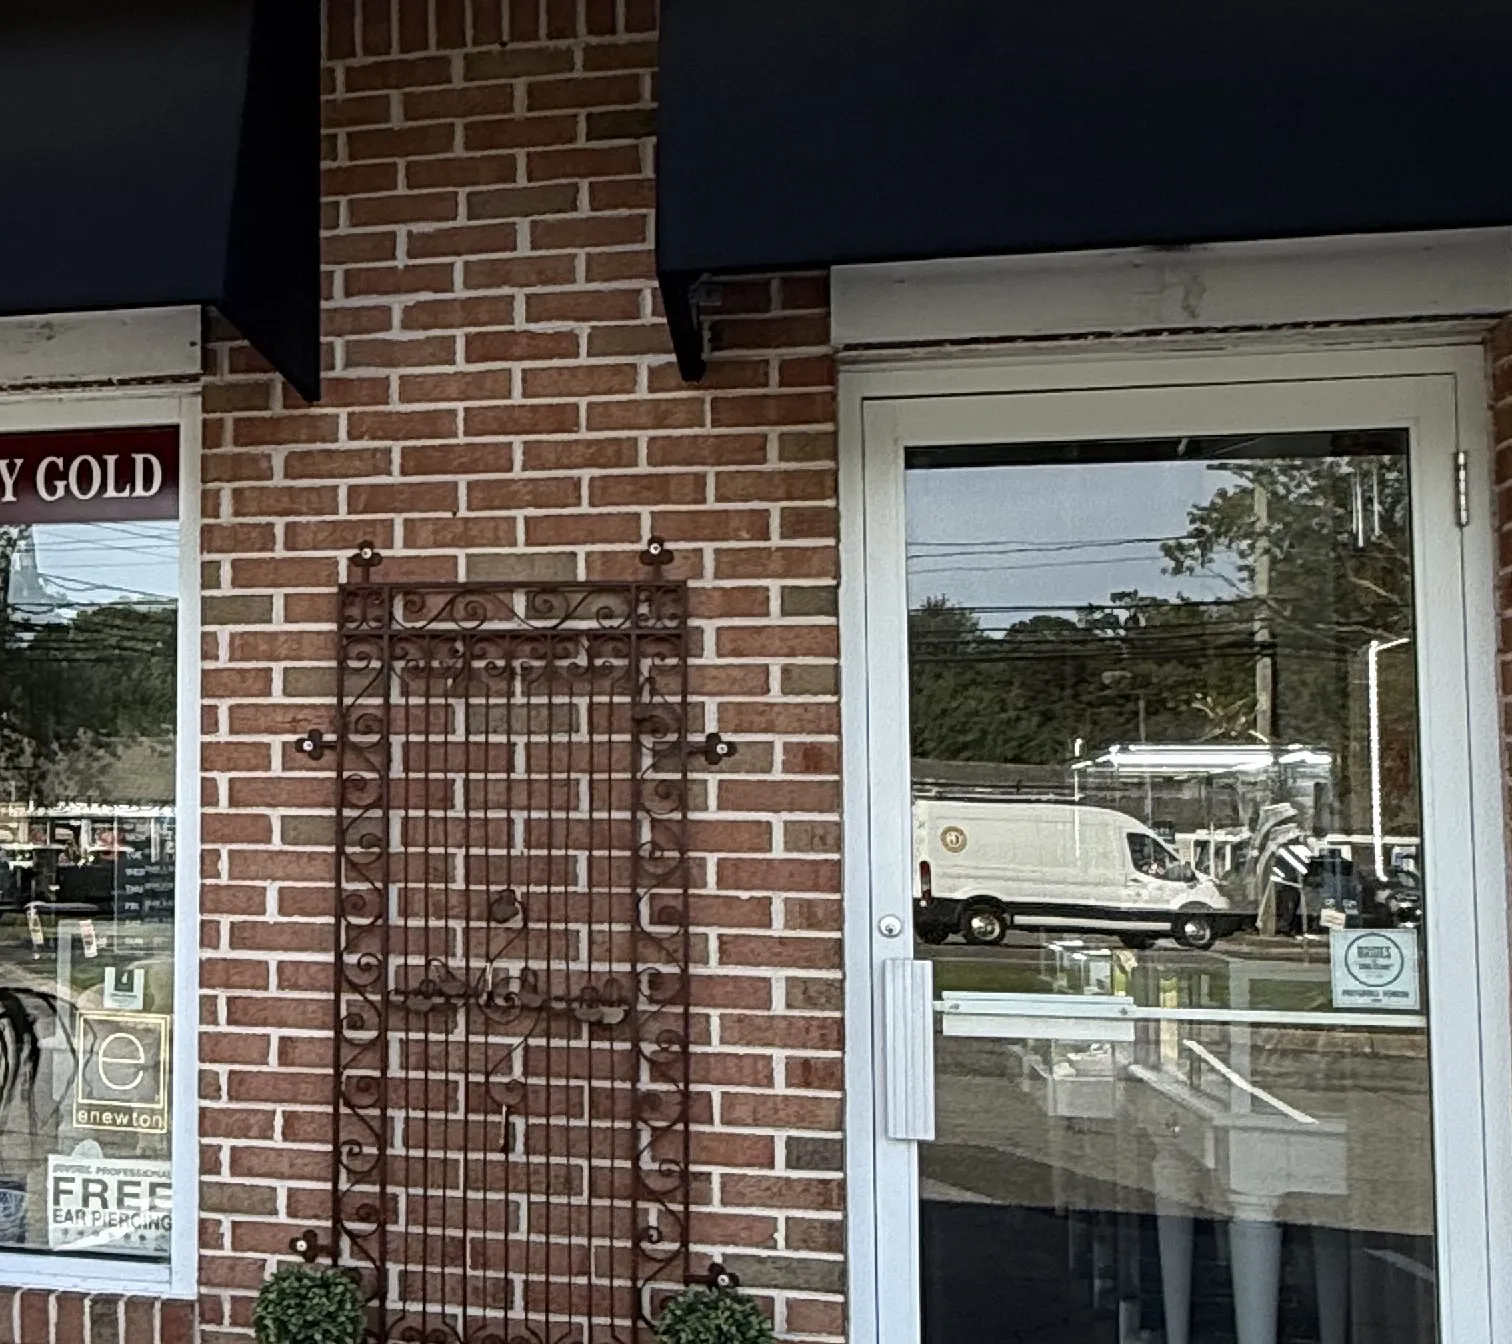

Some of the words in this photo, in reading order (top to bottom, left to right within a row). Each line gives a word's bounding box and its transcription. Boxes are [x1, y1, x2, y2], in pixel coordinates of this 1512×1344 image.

[35, 452, 162, 502] GOLD
[99, 1033, 145, 1090] e
[78, 1109, 164, 1129] enewton
[53, 1176, 172, 1212] FREE
[53, 1208, 85, 1226] EAR
[91, 1210, 172, 1232] PIERCING
